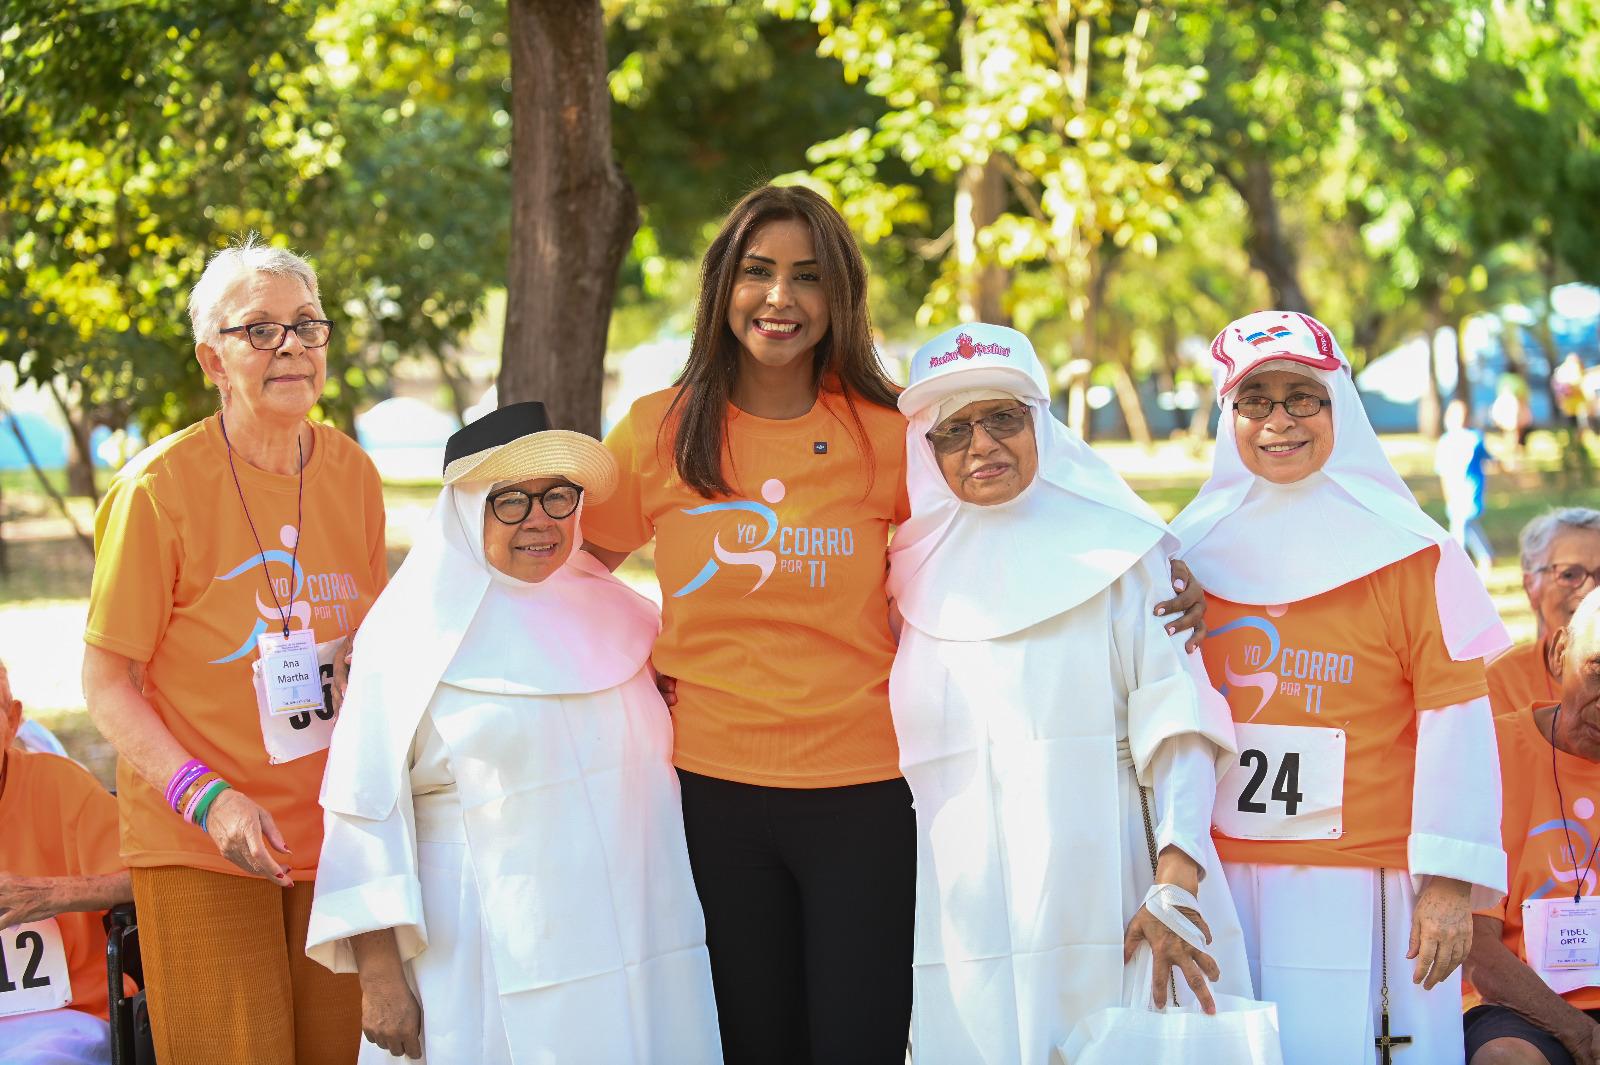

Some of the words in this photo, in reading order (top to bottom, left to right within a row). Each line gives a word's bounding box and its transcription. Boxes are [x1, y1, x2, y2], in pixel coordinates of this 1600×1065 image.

[737, 523, 757, 544] YO
[779, 526, 854, 556] CORRO
[272, 577, 289, 598] YO
[780, 559, 802, 573] POR
[808, 560, 826, 588] TI
[314, 605, 332, 620] POR
[333, 604, 349, 633] TI
[277, 672, 310, 684] Martha
[283, 659, 300, 669] Ana
[1244, 645, 1262, 666] YO
[1280, 647, 1354, 684] CORRO
[1280, 681, 1300, 697] POR
[1305, 683, 1322, 714] TI
[1237, 749, 1303, 816] 24
[1560, 928, 1588, 937] FIDEL
[1560, 937, 1587, 946] ORTIZ
